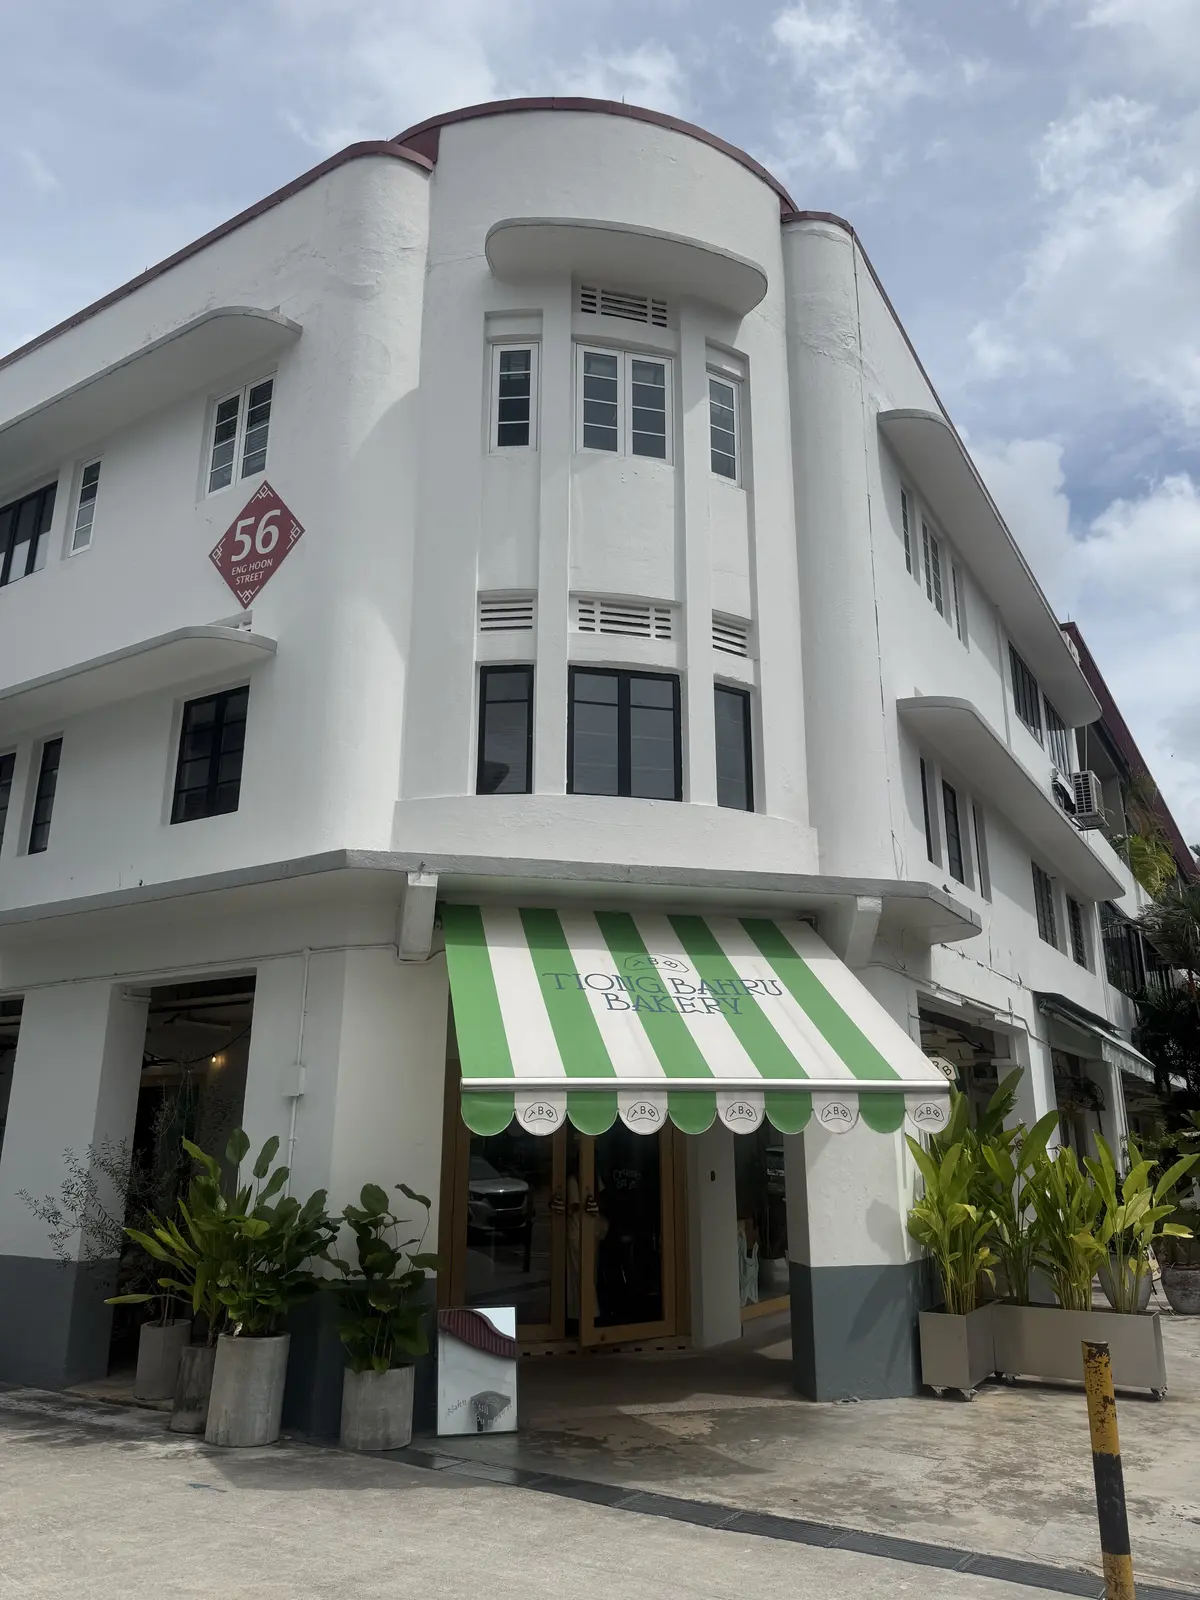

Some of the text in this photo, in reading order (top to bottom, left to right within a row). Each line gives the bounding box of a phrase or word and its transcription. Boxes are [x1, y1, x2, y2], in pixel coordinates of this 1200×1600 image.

[231, 509, 281, 562] 56
[231, 558, 273, 576] ENG HOON
[235, 571, 265, 586] STREET
[632, 956, 679, 969] TBB
[542, 973, 784, 997] TIONG BAHRU
[600, 992, 743, 1015] BAKERY
[527, 1105, 555, 1119] TBB
[630, 1105, 656, 1118] TBB
[729, 1105, 754, 1118] TBB
[824, 1106, 849, 1118] TBB
[917, 1106, 941, 1118] TBB
